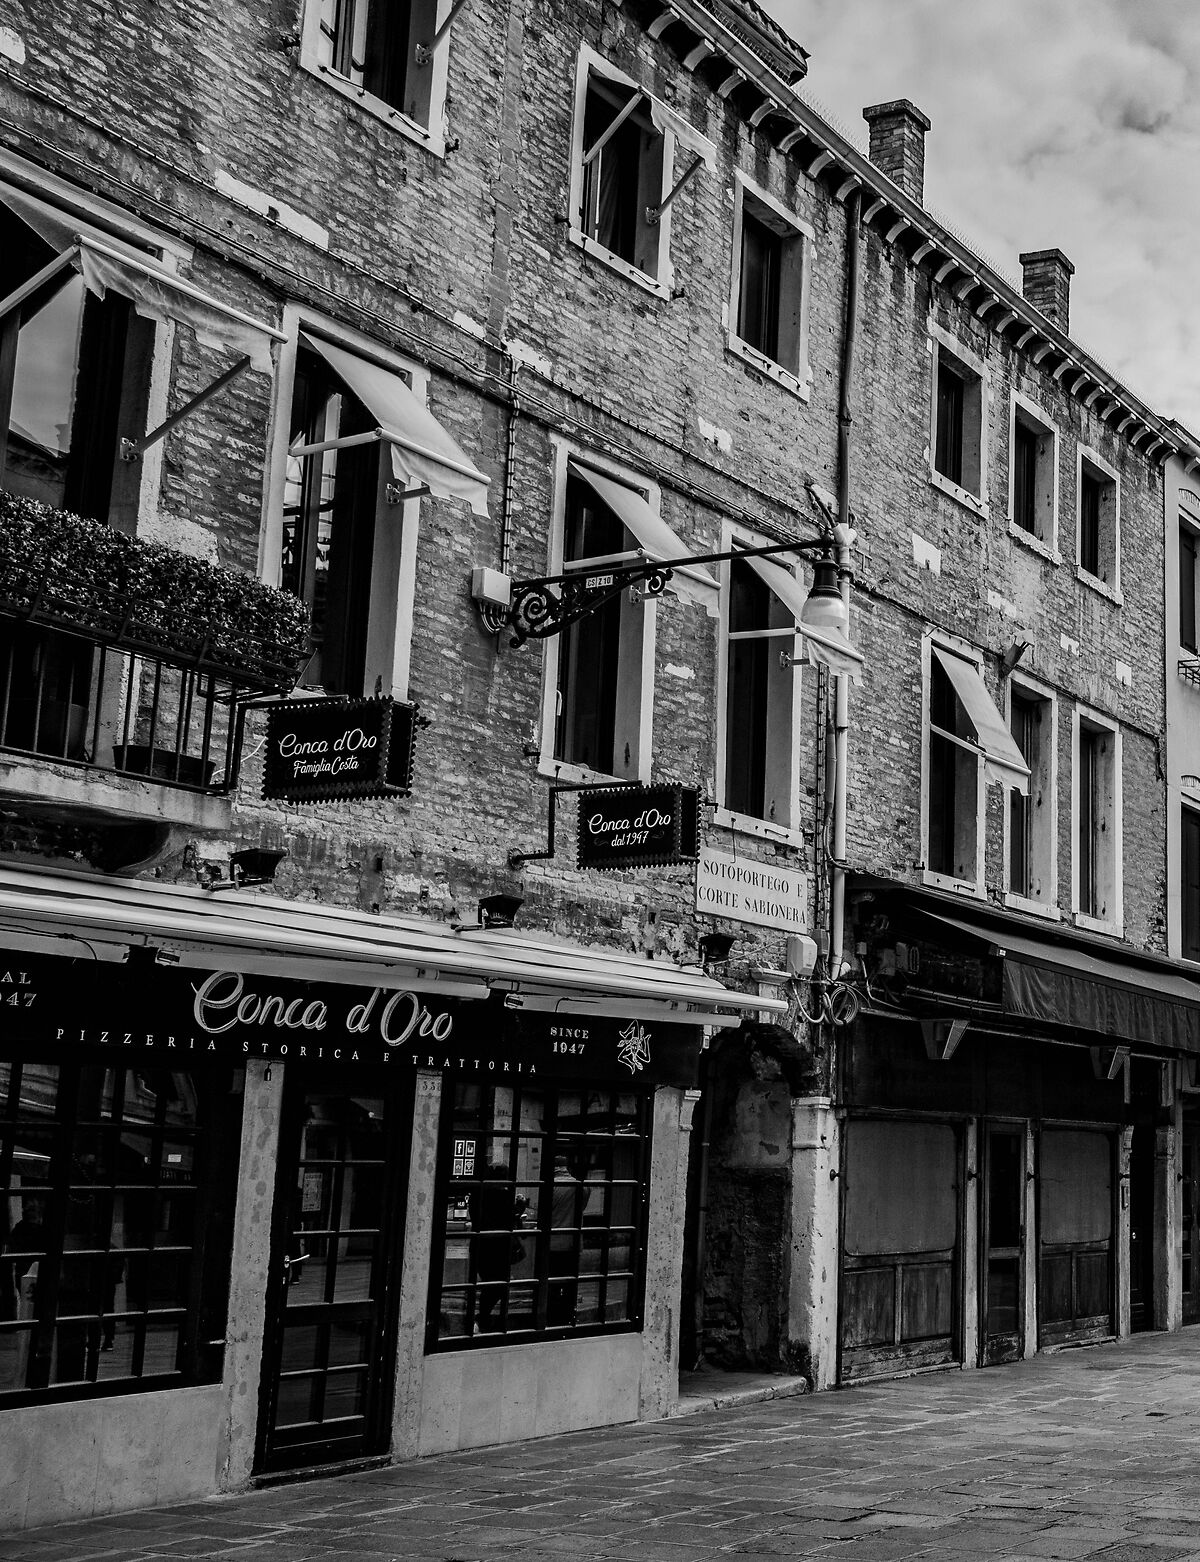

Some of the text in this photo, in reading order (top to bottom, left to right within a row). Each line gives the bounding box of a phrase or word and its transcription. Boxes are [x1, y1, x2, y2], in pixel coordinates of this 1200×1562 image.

[278, 728, 377, 757] Conca d'Oro
[293, 755, 359, 778] Famiglia Costa
[587, 808, 671, 834] Conca d'Oro
[611, 830, 650, 847] dal 1947
[703, 859, 803, 898] SOTOPORTEGO E
[698, 886, 806, 924] CORTE SABIONERA
[0, 971, 32, 985] AL
[190, 969, 453, 1047] Conca d'Oro
[550, 1026, 589, 1040] SINCE
[56, 1028, 537, 1073] PIZZERIA STORICA E TRATTORIA
[552, 1041, 586, 1055] 1947
